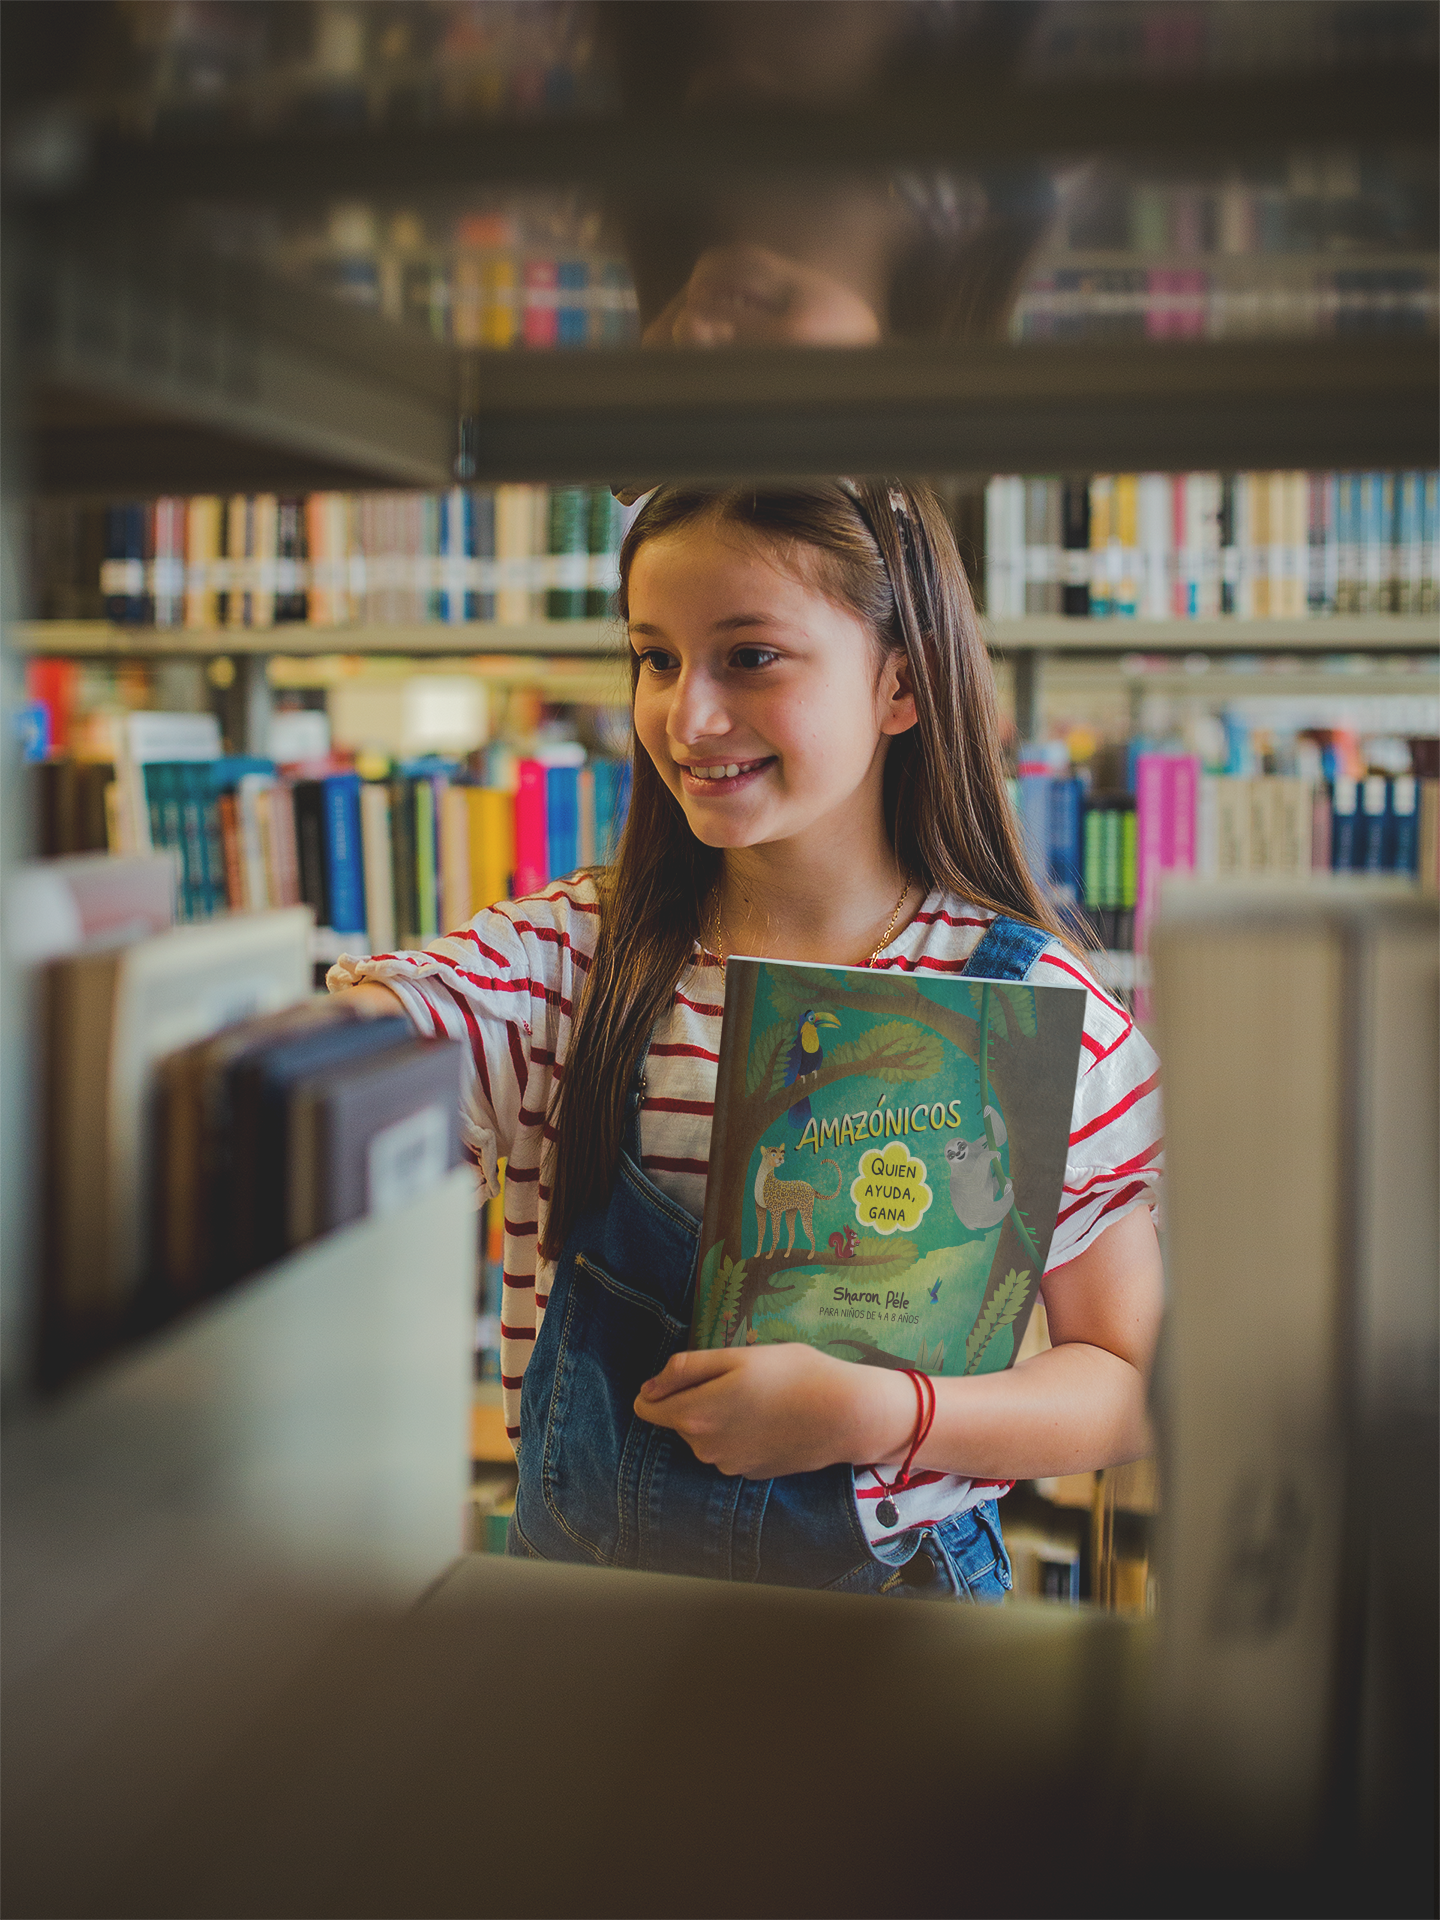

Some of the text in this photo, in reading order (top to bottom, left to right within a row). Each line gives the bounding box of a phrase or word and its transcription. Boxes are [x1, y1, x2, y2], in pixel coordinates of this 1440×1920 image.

[794, 1093, 962, 1154] AMAZÓNICOS
[871, 1157, 917, 1179] QUIEN
[864, 1184, 916, 1203] AYUDA,
[868, 1206, 906, 1222] GANA
[833, 1286, 910, 1310] Sharon Péle
[819, 1306, 920, 1325] PARA NIÑOS DE 4 A 8 AÑOS
